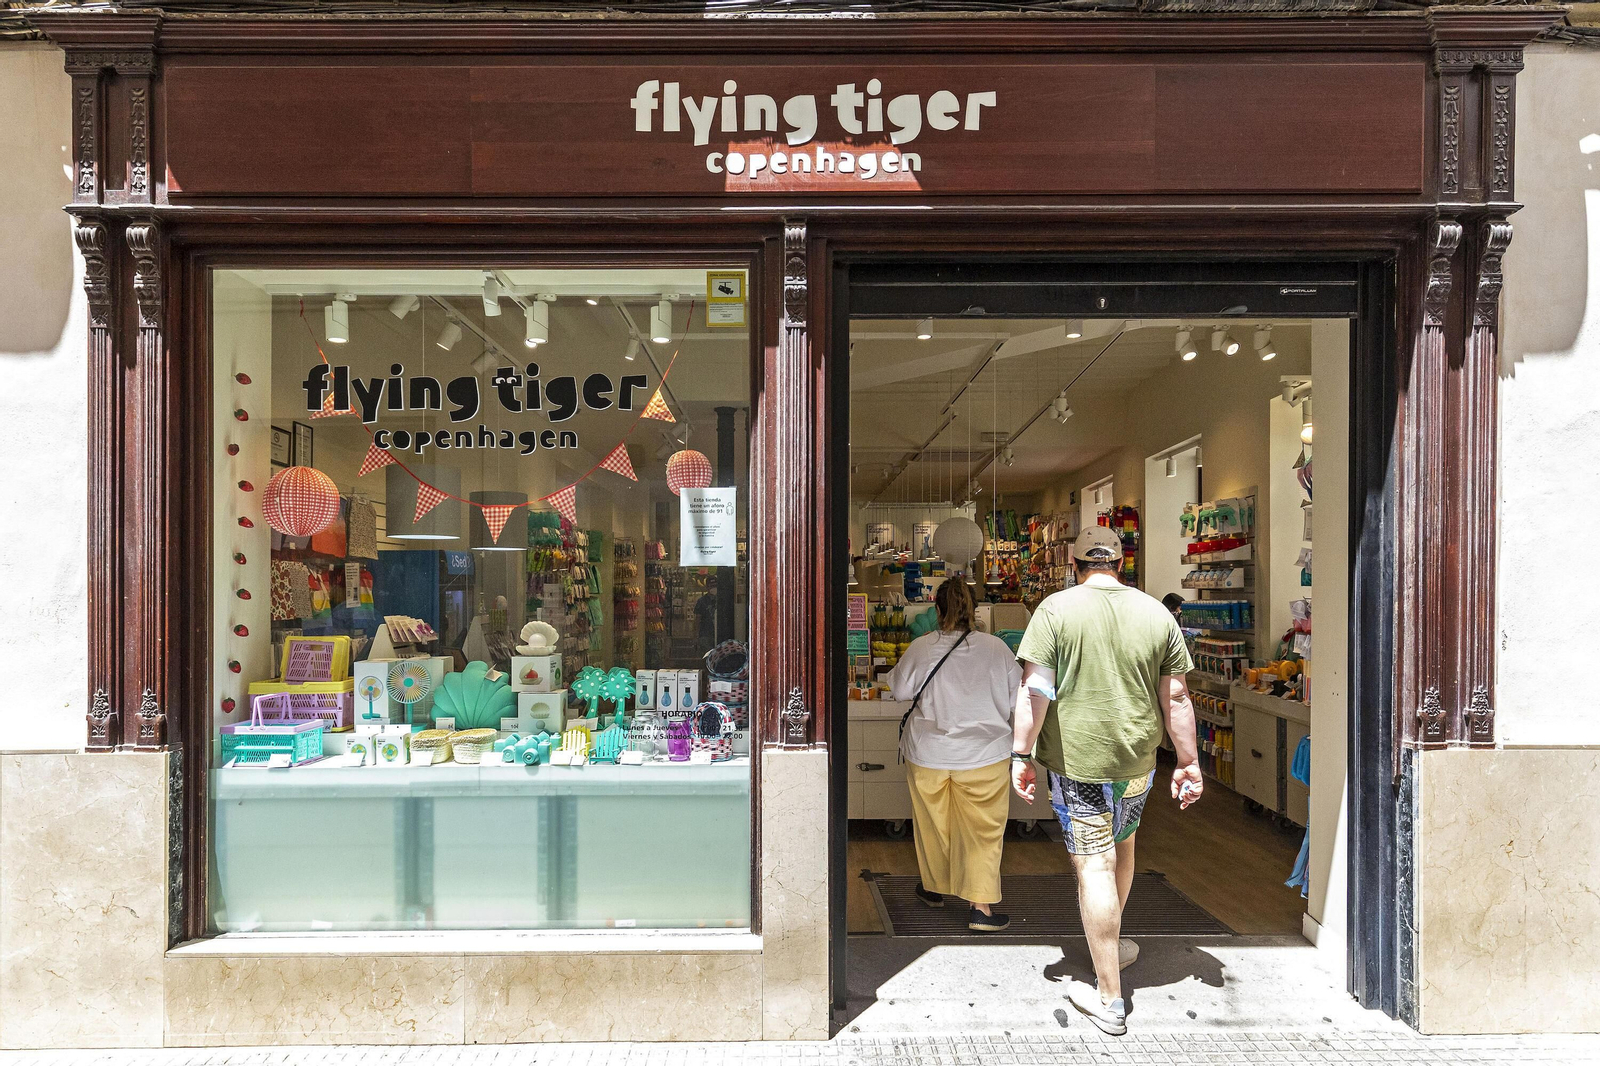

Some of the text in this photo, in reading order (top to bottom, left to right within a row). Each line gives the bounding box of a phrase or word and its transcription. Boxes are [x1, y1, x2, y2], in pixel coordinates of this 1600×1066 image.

[630, 78, 997, 147] flying tiger
[706, 146, 922, 179] copenhagen
[302, 362, 648, 424] flying tiger
[374, 424, 579, 456] copenhagen
[661, 710, 703, 718] HORARIO
